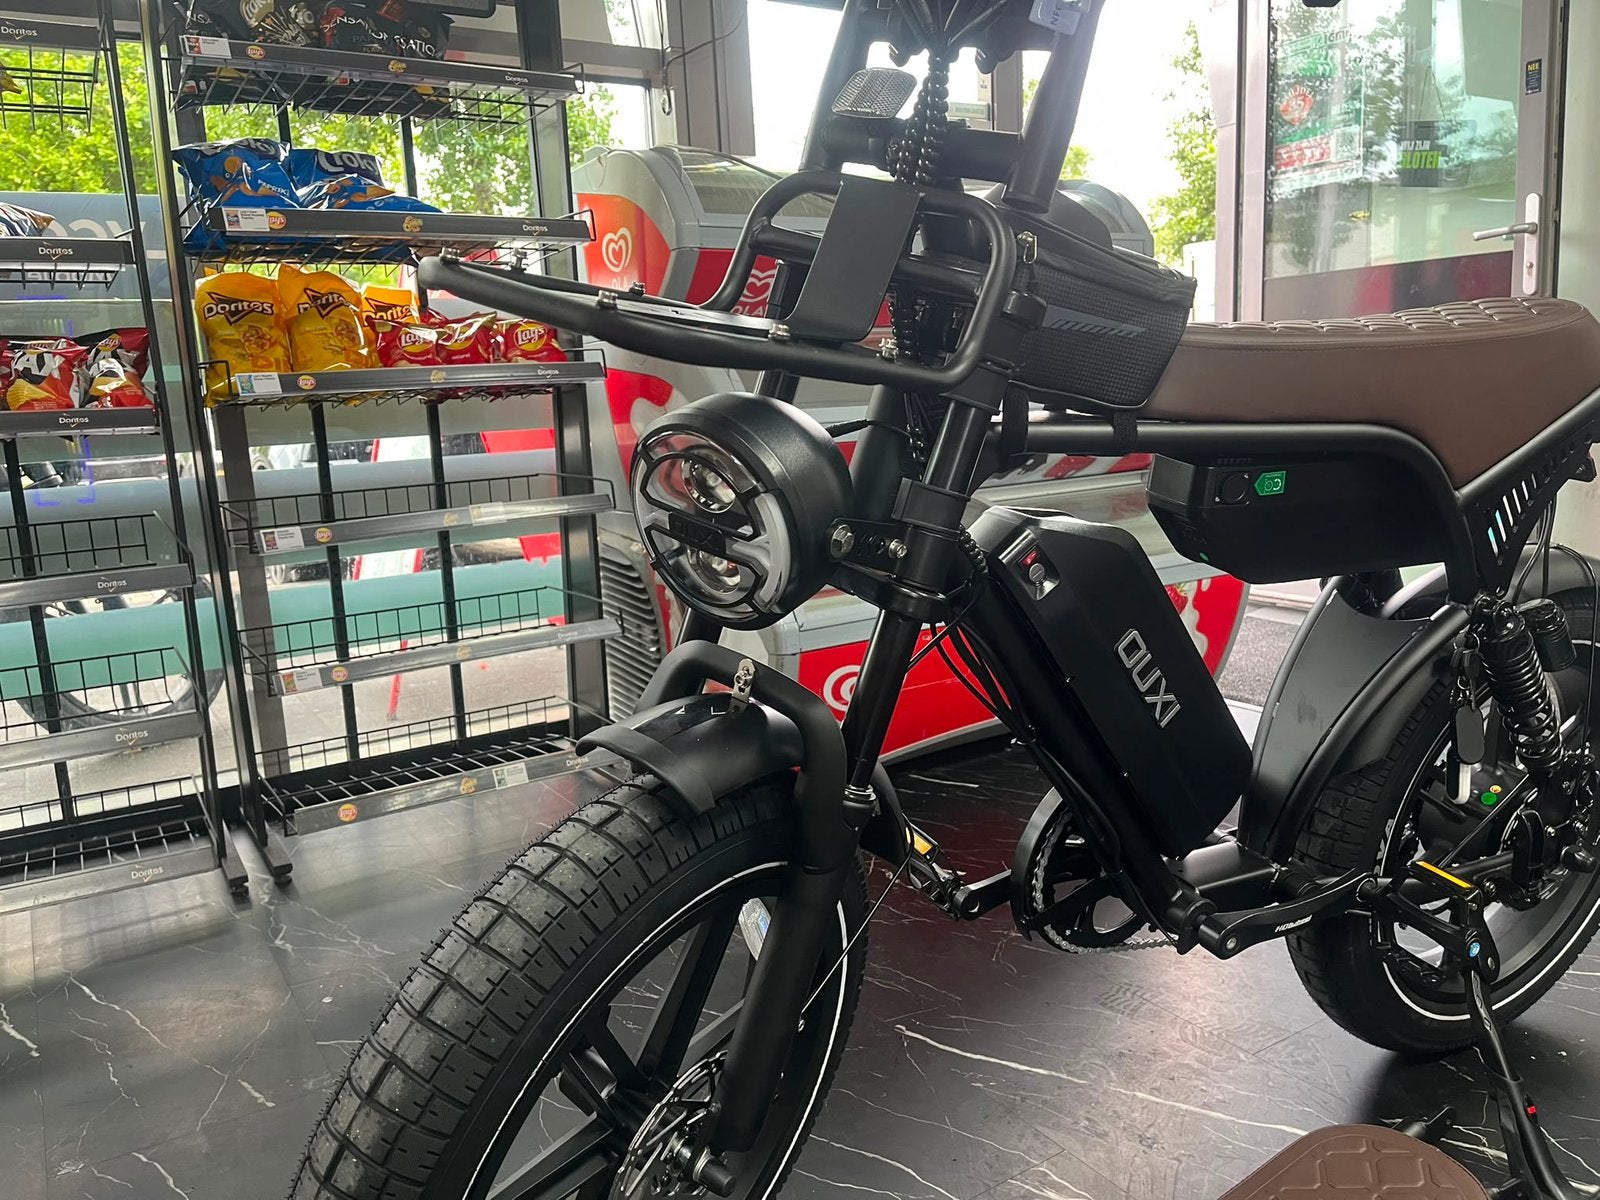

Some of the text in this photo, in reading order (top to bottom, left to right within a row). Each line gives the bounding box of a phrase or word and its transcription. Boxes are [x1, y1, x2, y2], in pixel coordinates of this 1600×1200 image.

[1, 26, 38, 37] Doritos
[522, 224, 548, 232] Doritos
[38, 246, 74, 256] Doritos
[203, 301, 274, 319] Doritos
[363, 304, 412, 326] Dorito
[730, 305, 764, 316] OLA
[59, 416, 90, 425] Doritos
[97, 579, 128, 589] Doritos
[115, 730, 149, 742] Doritos
[131, 866, 164, 879] Doritos
